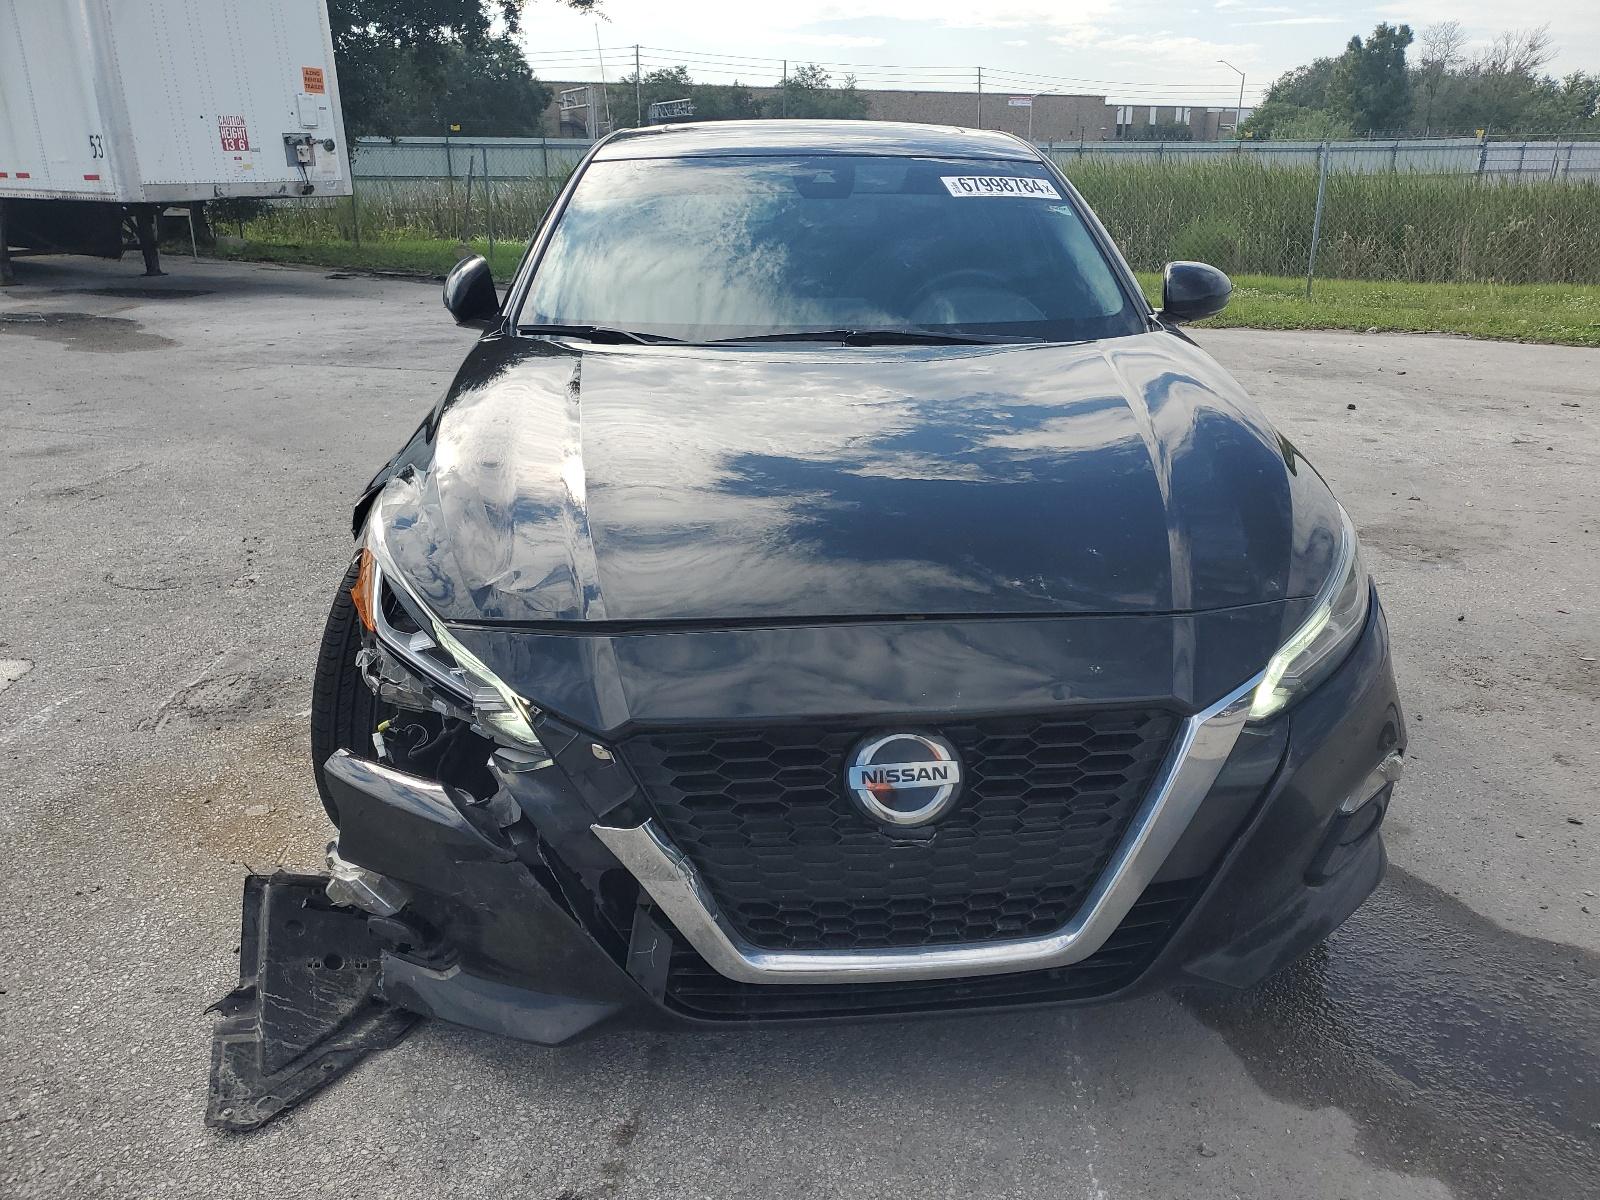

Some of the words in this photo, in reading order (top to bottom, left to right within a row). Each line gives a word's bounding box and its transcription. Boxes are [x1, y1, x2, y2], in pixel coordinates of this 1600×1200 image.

[218, 115, 245, 125] CAUTION
[221, 127, 247, 139] HEIGHT
[957, 177, 1044, 193] 67998784
[861, 765, 948, 784] NISSAN
